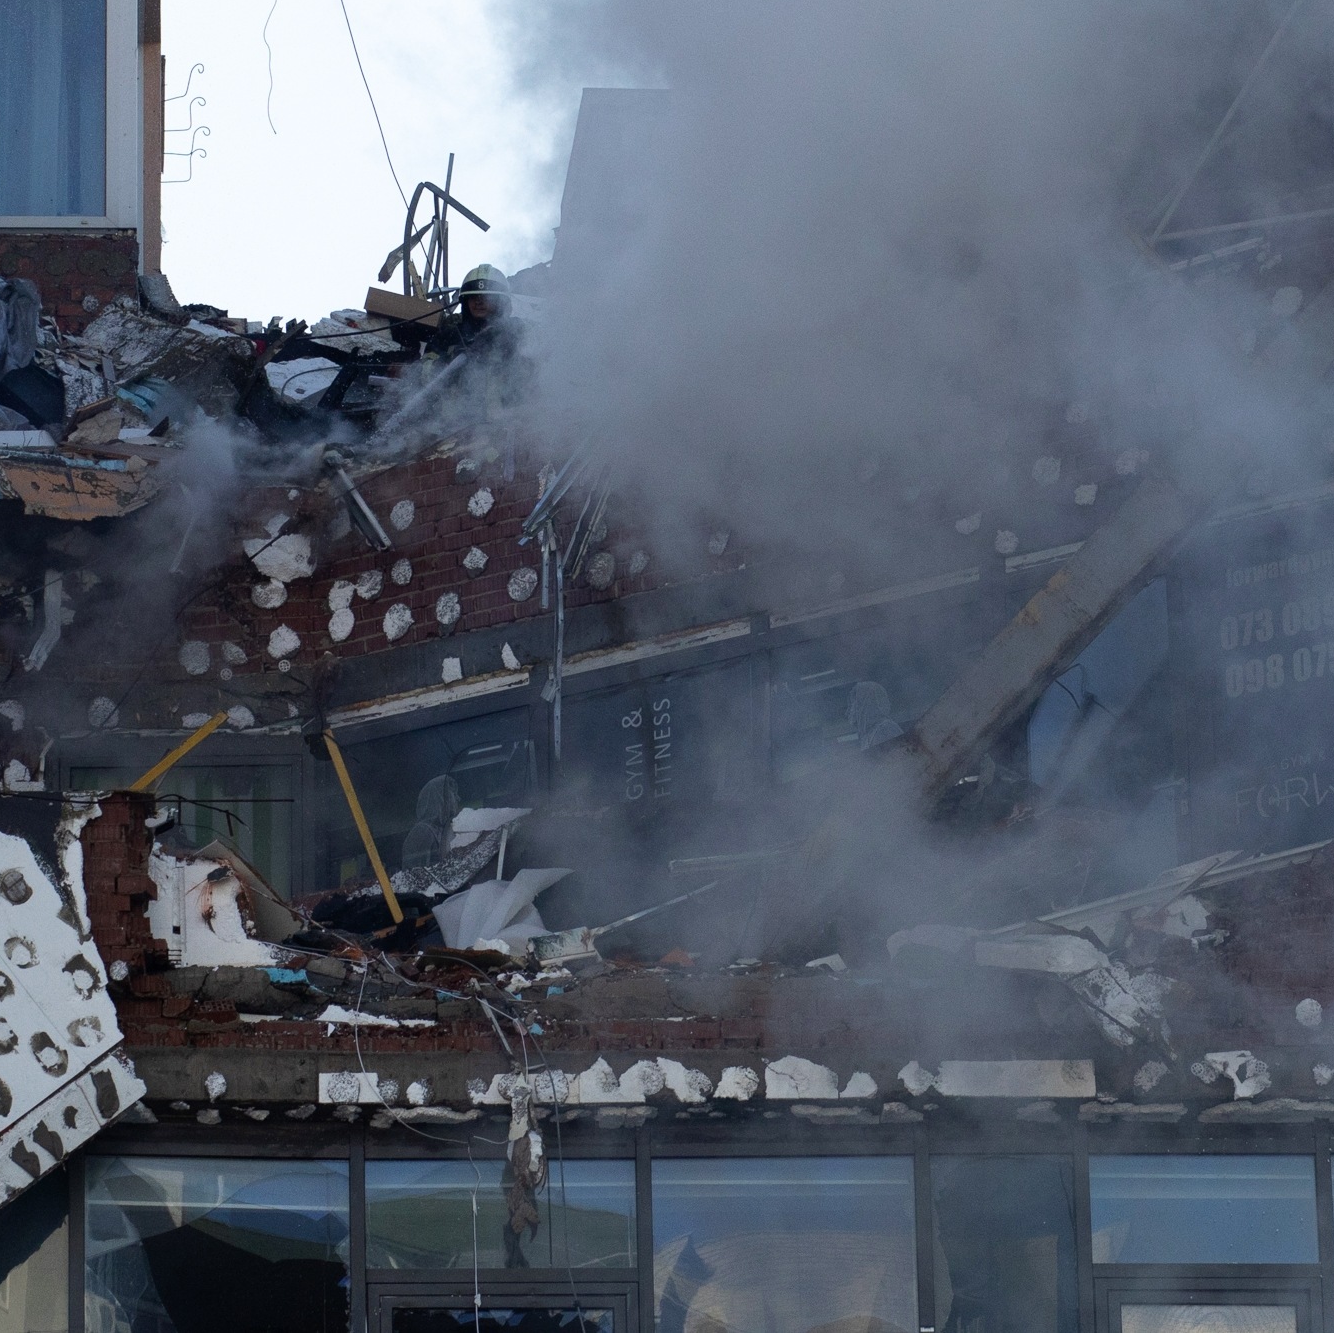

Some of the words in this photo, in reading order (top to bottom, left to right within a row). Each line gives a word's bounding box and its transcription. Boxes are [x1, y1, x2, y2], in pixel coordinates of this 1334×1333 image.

[1220, 608, 1275, 650] 073
[1225, 653, 1285, 697] 098
[621, 706, 643, 729] &
[652, 698, 672, 799] FITNESS
[1280, 751, 1312, 770] GYM
[625, 742, 644, 801] GYM
